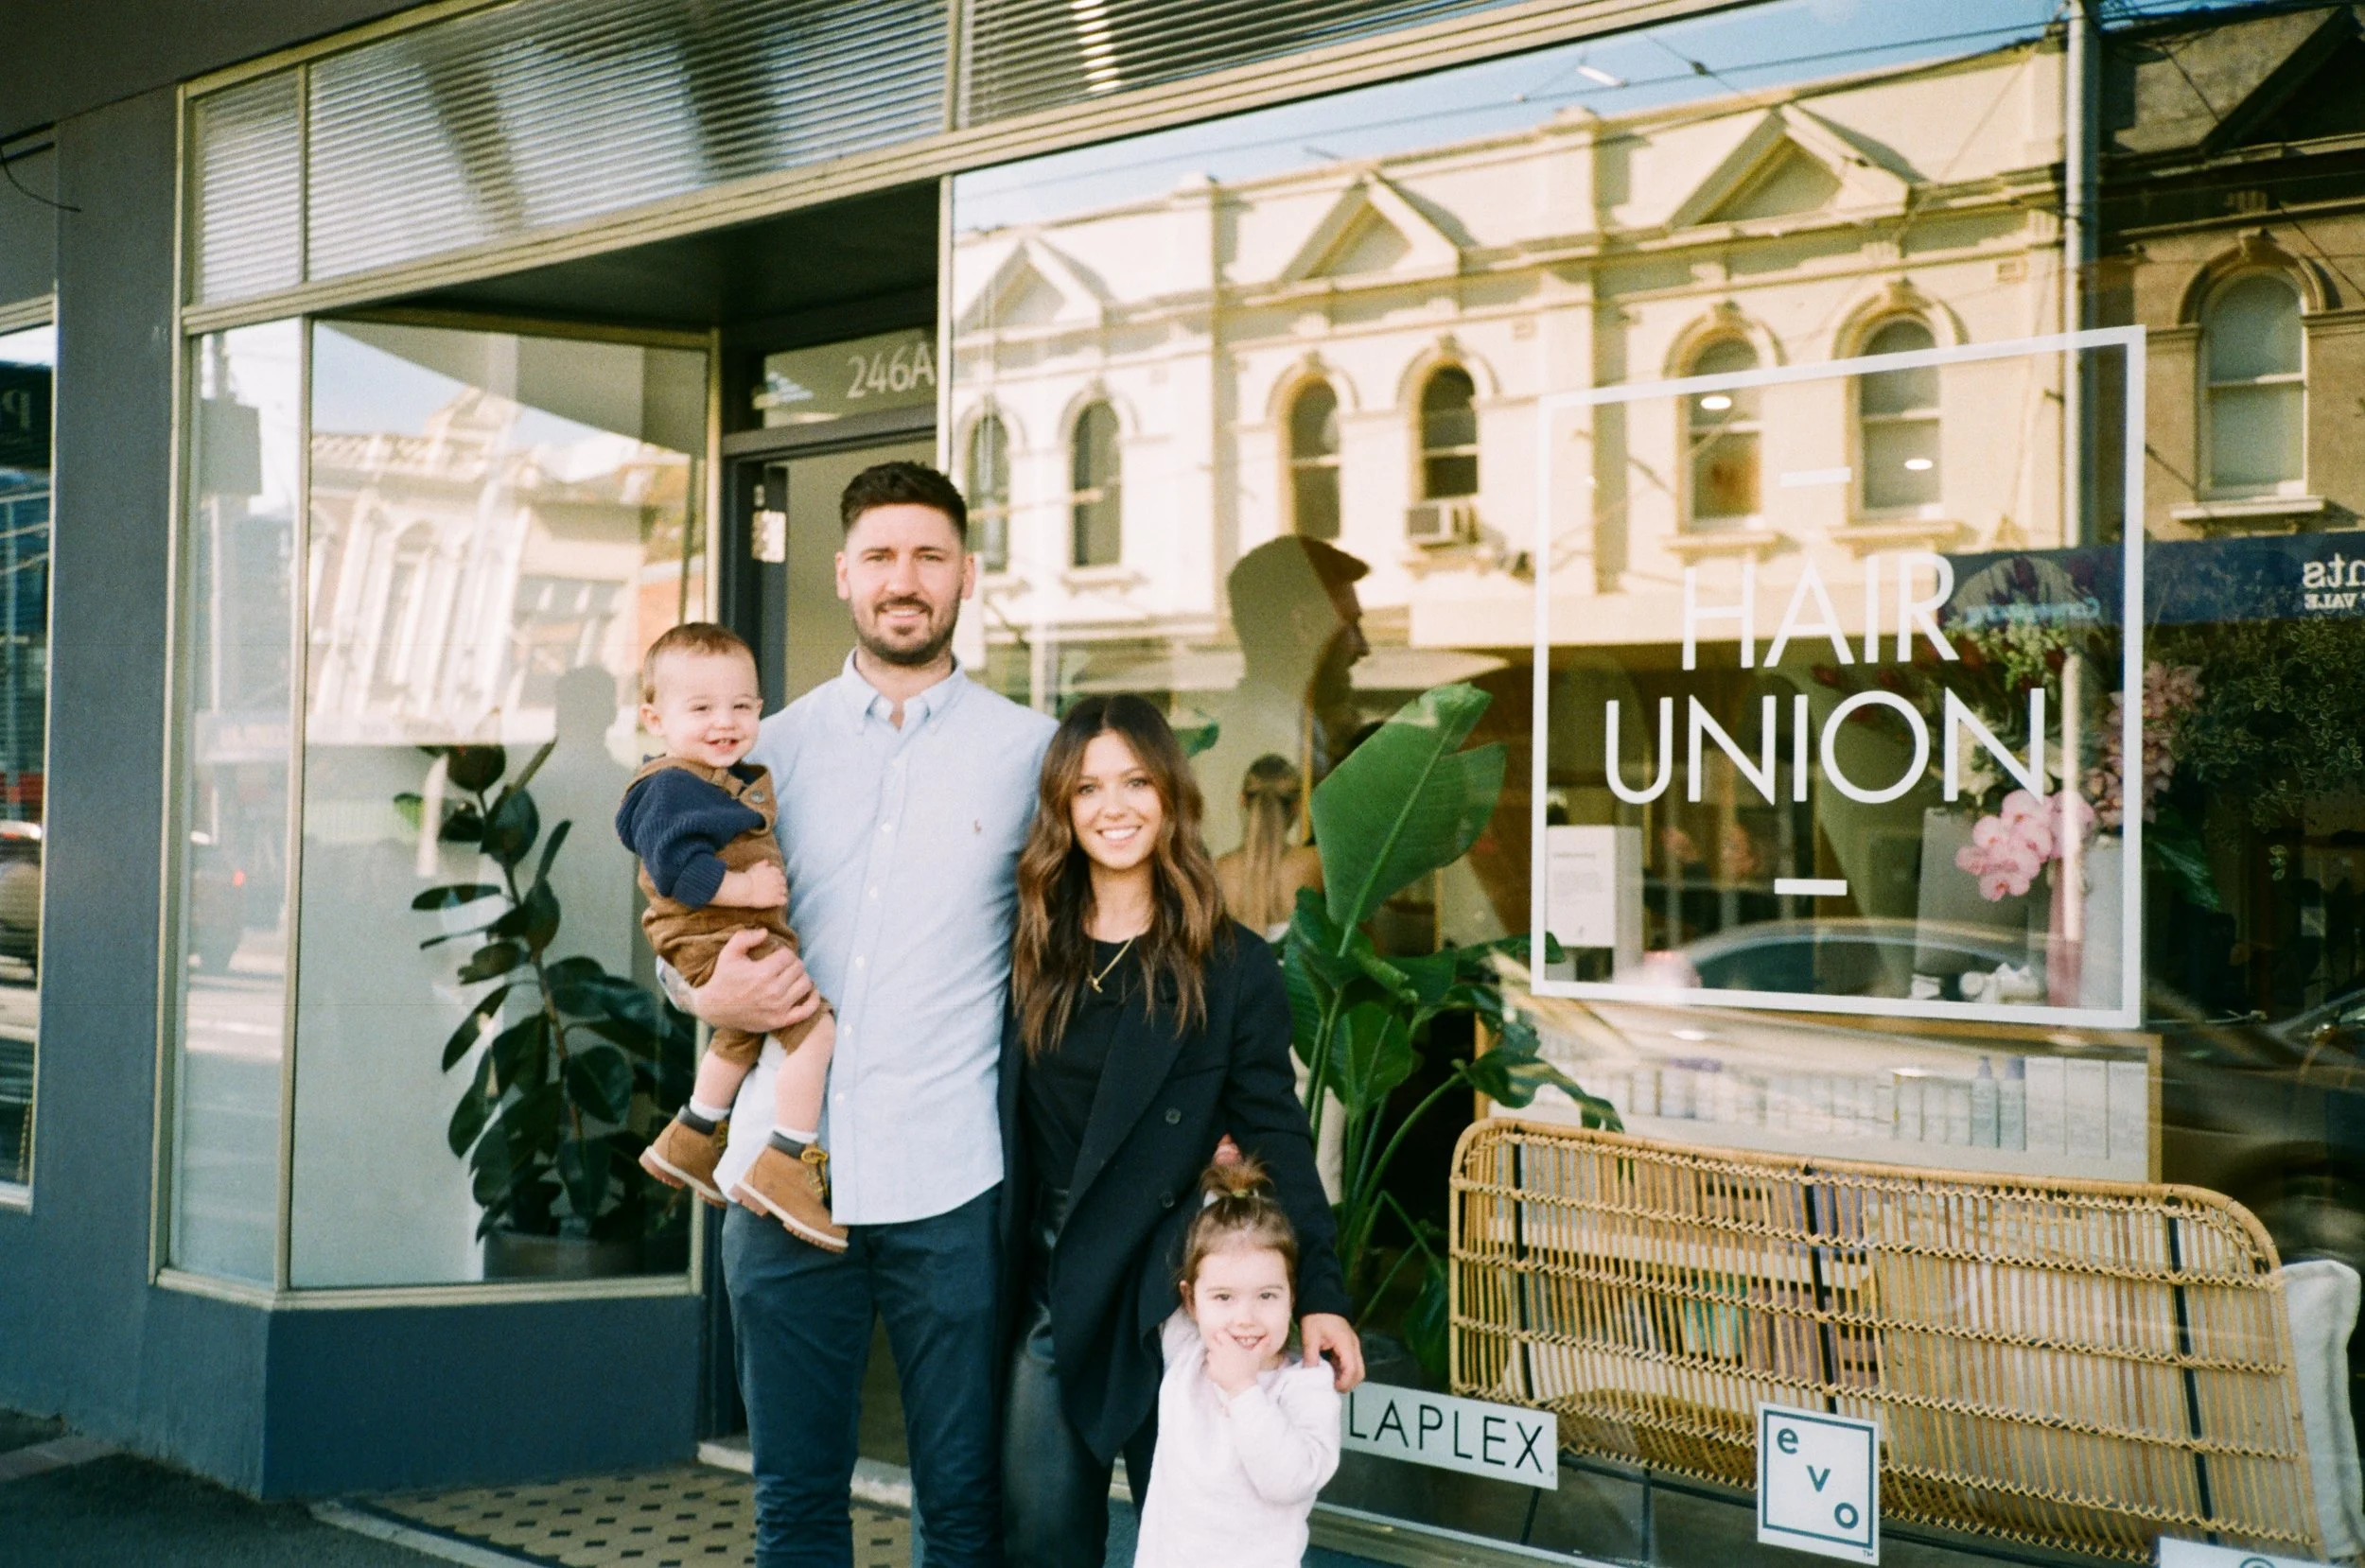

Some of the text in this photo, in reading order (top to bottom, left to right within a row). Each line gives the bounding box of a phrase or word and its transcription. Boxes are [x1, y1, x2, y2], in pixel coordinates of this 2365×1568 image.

[845, 341, 936, 398] 246A
[1682, 552, 1960, 671] HAIR
[1605, 688, 2045, 806] UNION
[1777, 1428, 1859, 1529] evo
